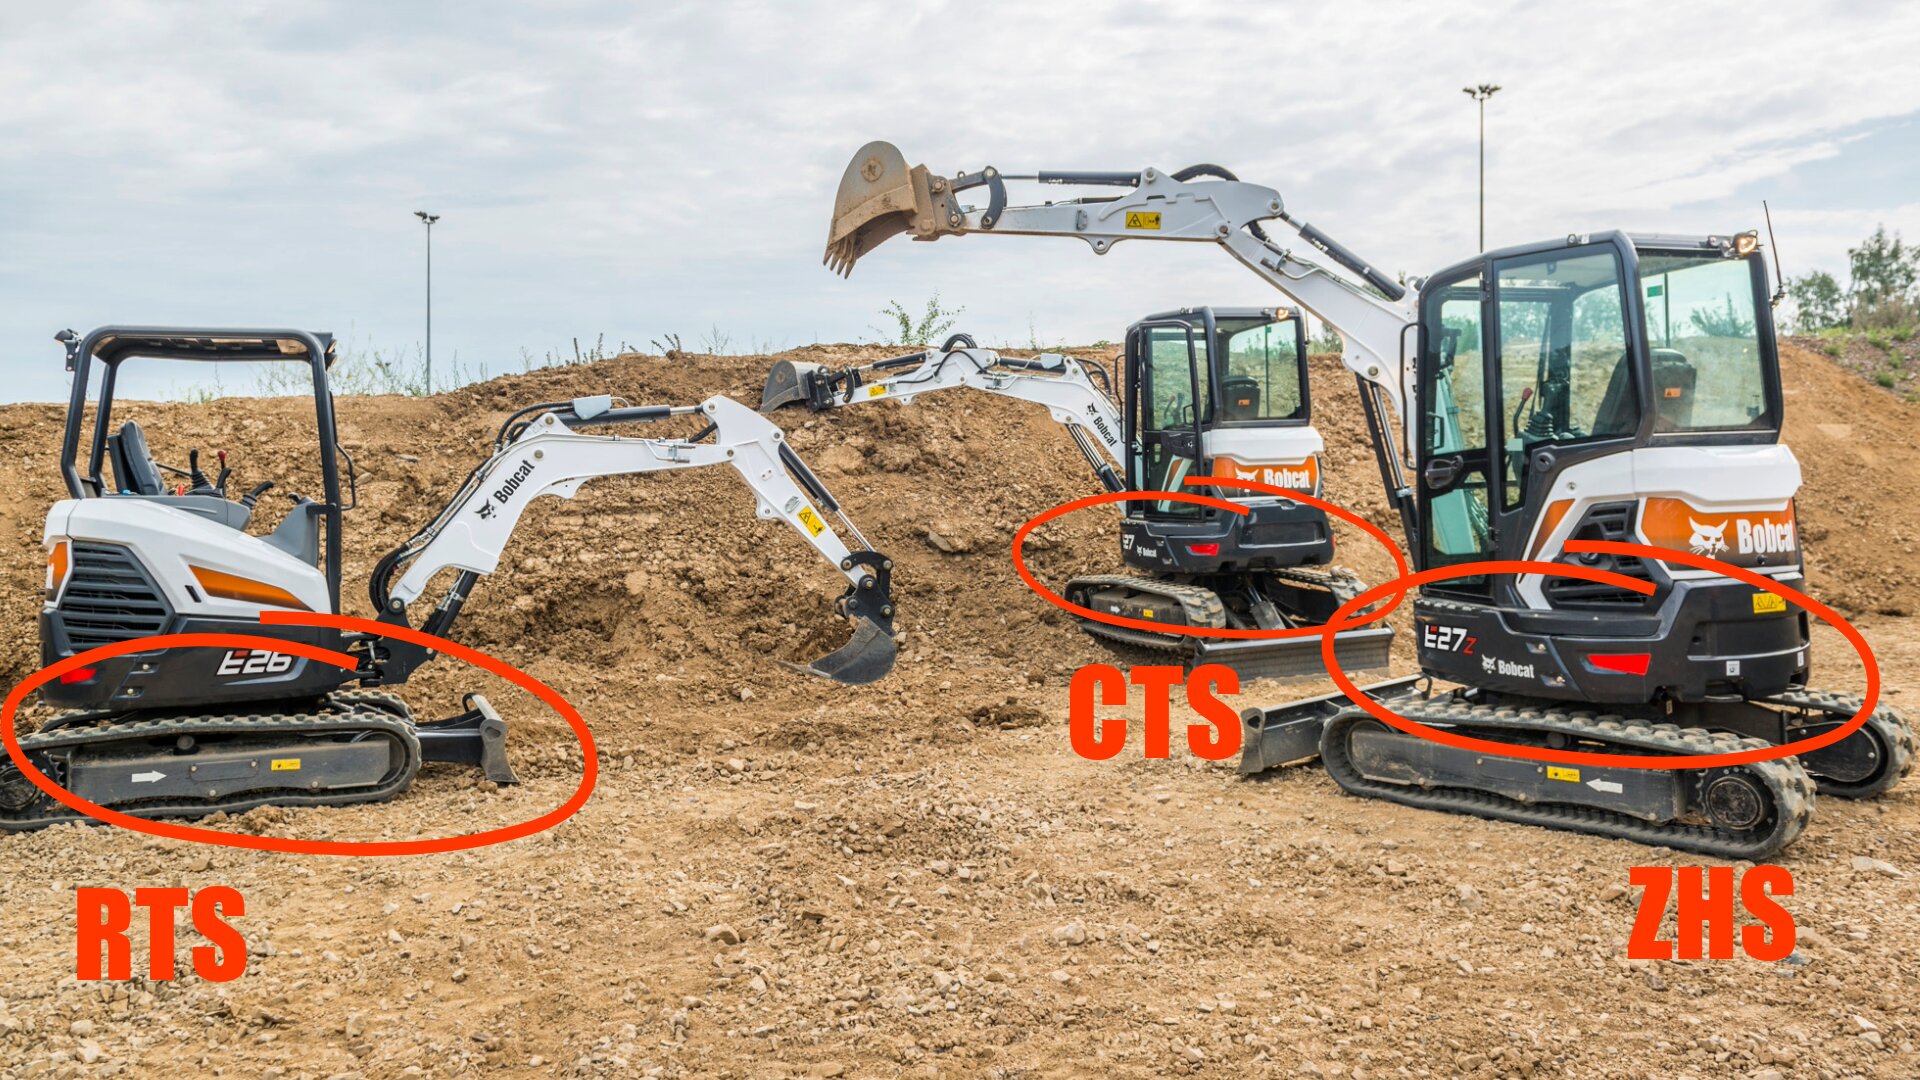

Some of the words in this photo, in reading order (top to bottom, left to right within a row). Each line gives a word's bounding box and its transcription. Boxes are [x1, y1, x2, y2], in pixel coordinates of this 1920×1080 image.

[1093, 416, 1117, 447] Bobcat
[493, 459, 535, 504] Bobcat
[1263, 468, 1311, 488] Bobcat
[1736, 517, 1796, 554] Bobcat
[216, 649, 292, 675] E26
[1498, 659, 1535, 679] Bobcat
